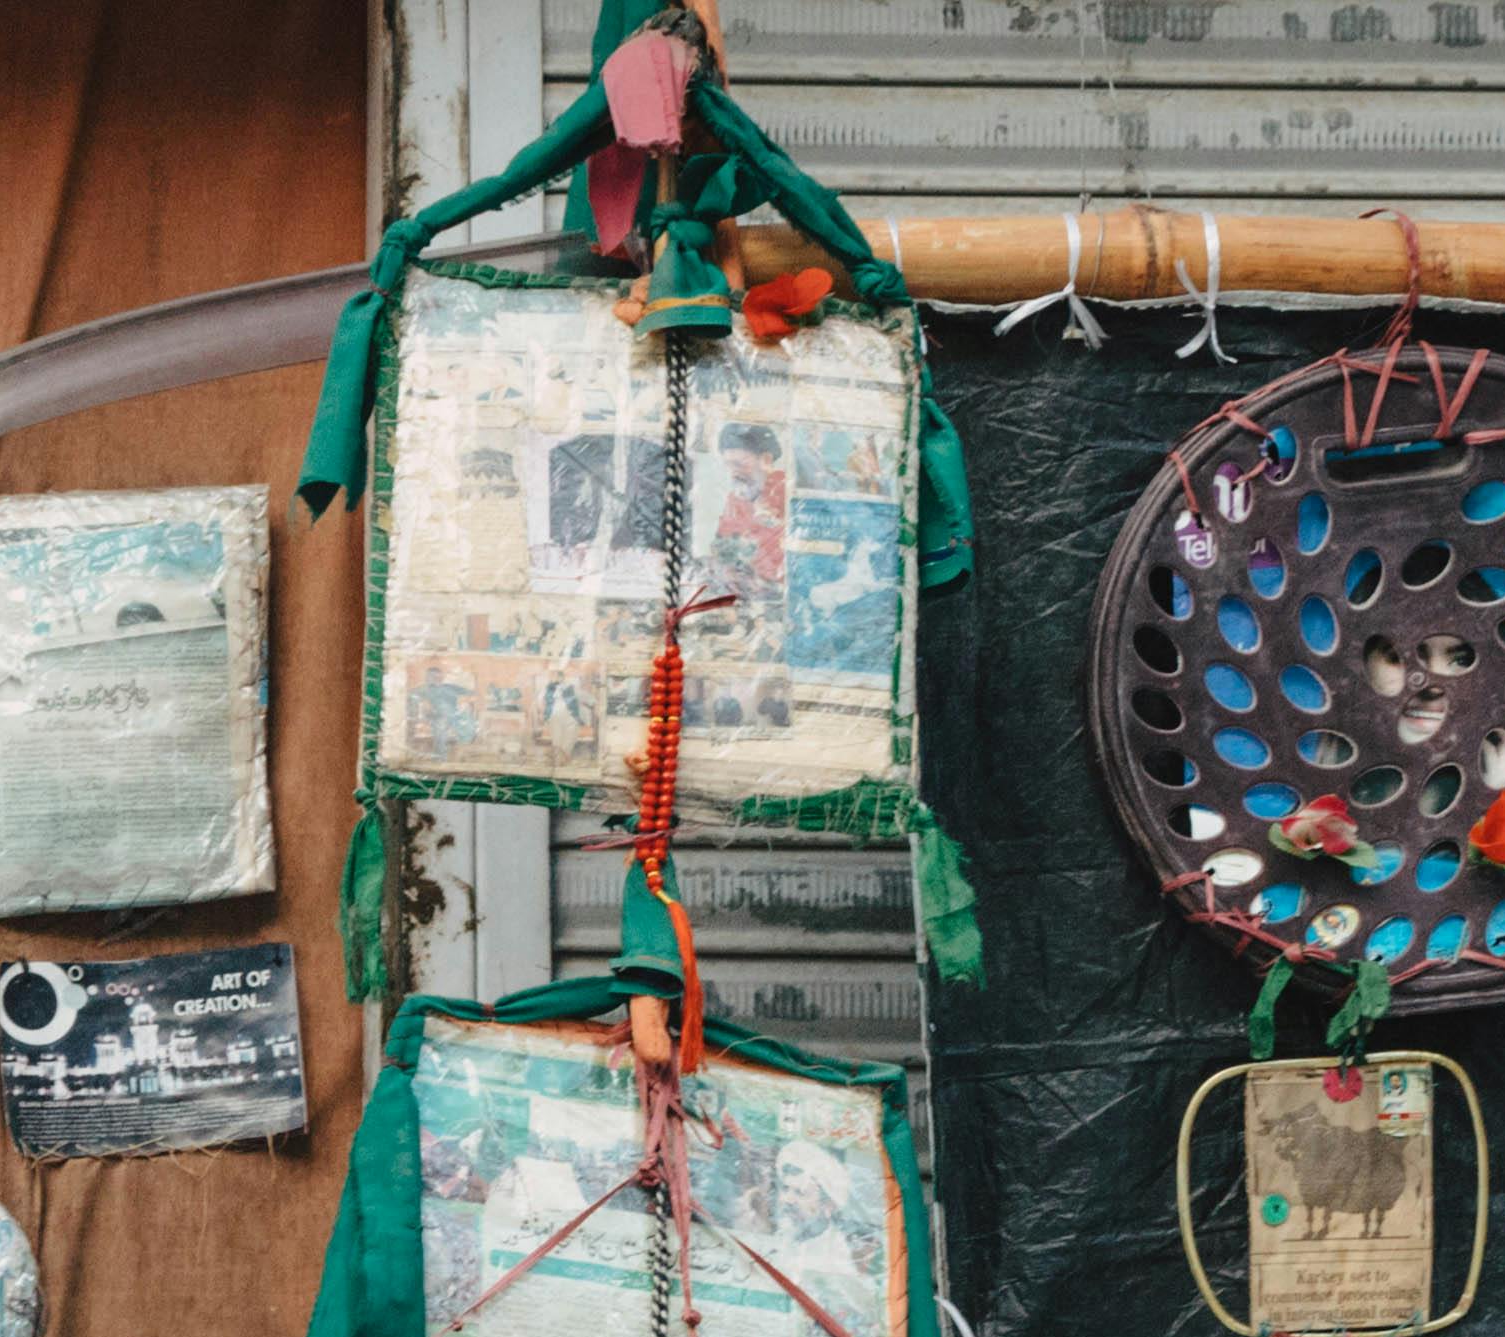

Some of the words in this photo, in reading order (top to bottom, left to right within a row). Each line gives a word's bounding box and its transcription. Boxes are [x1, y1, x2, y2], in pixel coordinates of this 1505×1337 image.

[211, 972, 243, 992] ART
[245, 968, 271, 988] OF
[1350, 1271, 1372, 1283] set
[1375, 1270, 1390, 1283] to
